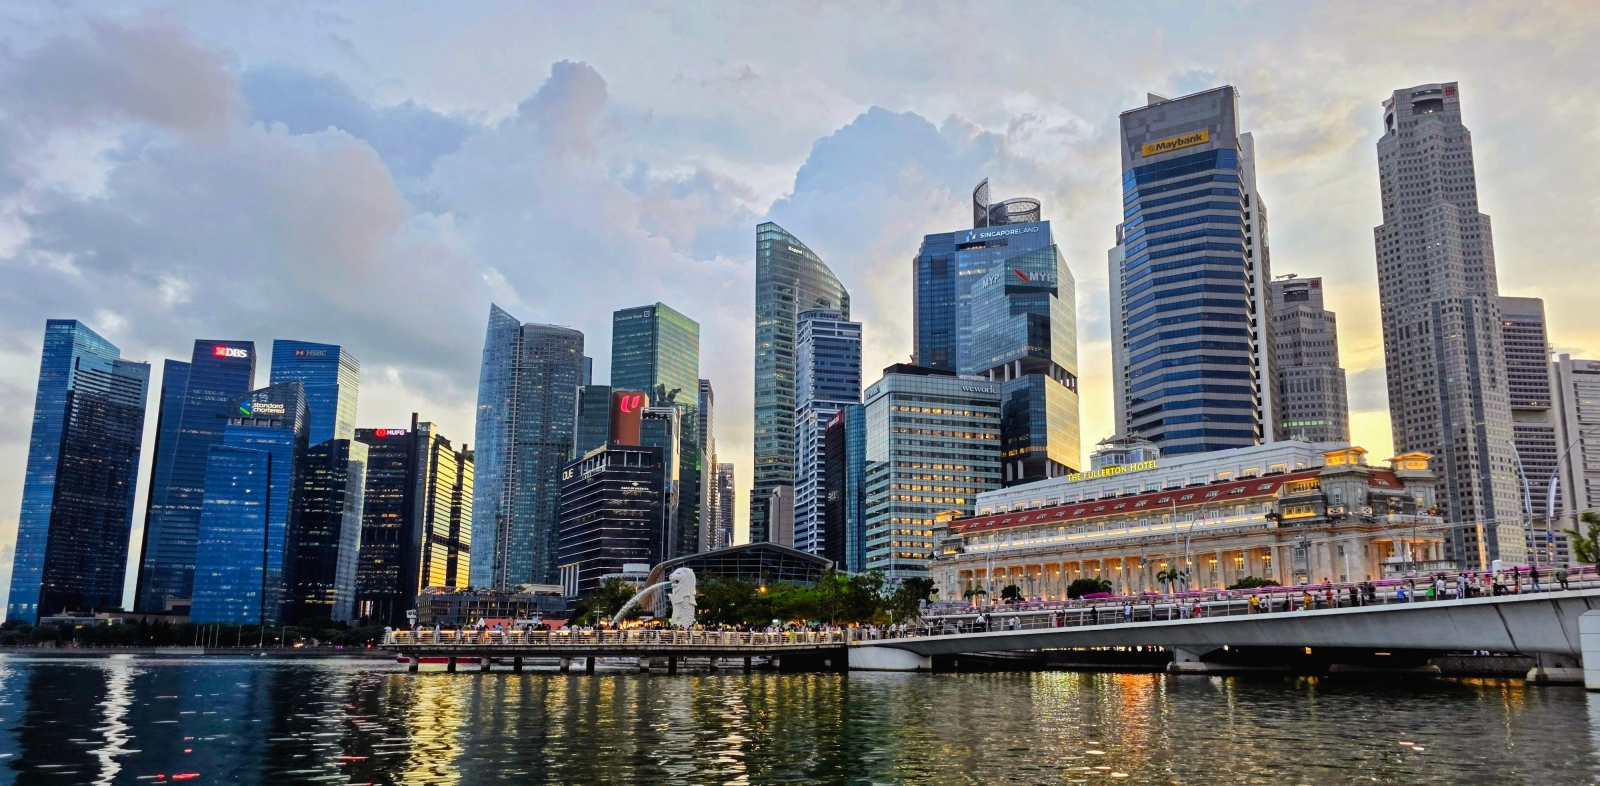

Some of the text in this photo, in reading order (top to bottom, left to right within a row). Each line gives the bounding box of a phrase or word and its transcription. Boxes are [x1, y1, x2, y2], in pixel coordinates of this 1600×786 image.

[1155, 134, 1202, 150] Maybank
[980, 226, 1039, 239] SINGAPORELAND
[982, 274, 1000, 289] MYP
[226, 348, 247, 358] DBS
[961, 385, 996, 394] wework
[1067, 460, 1158, 482] THE FULLERTON HOTEL
